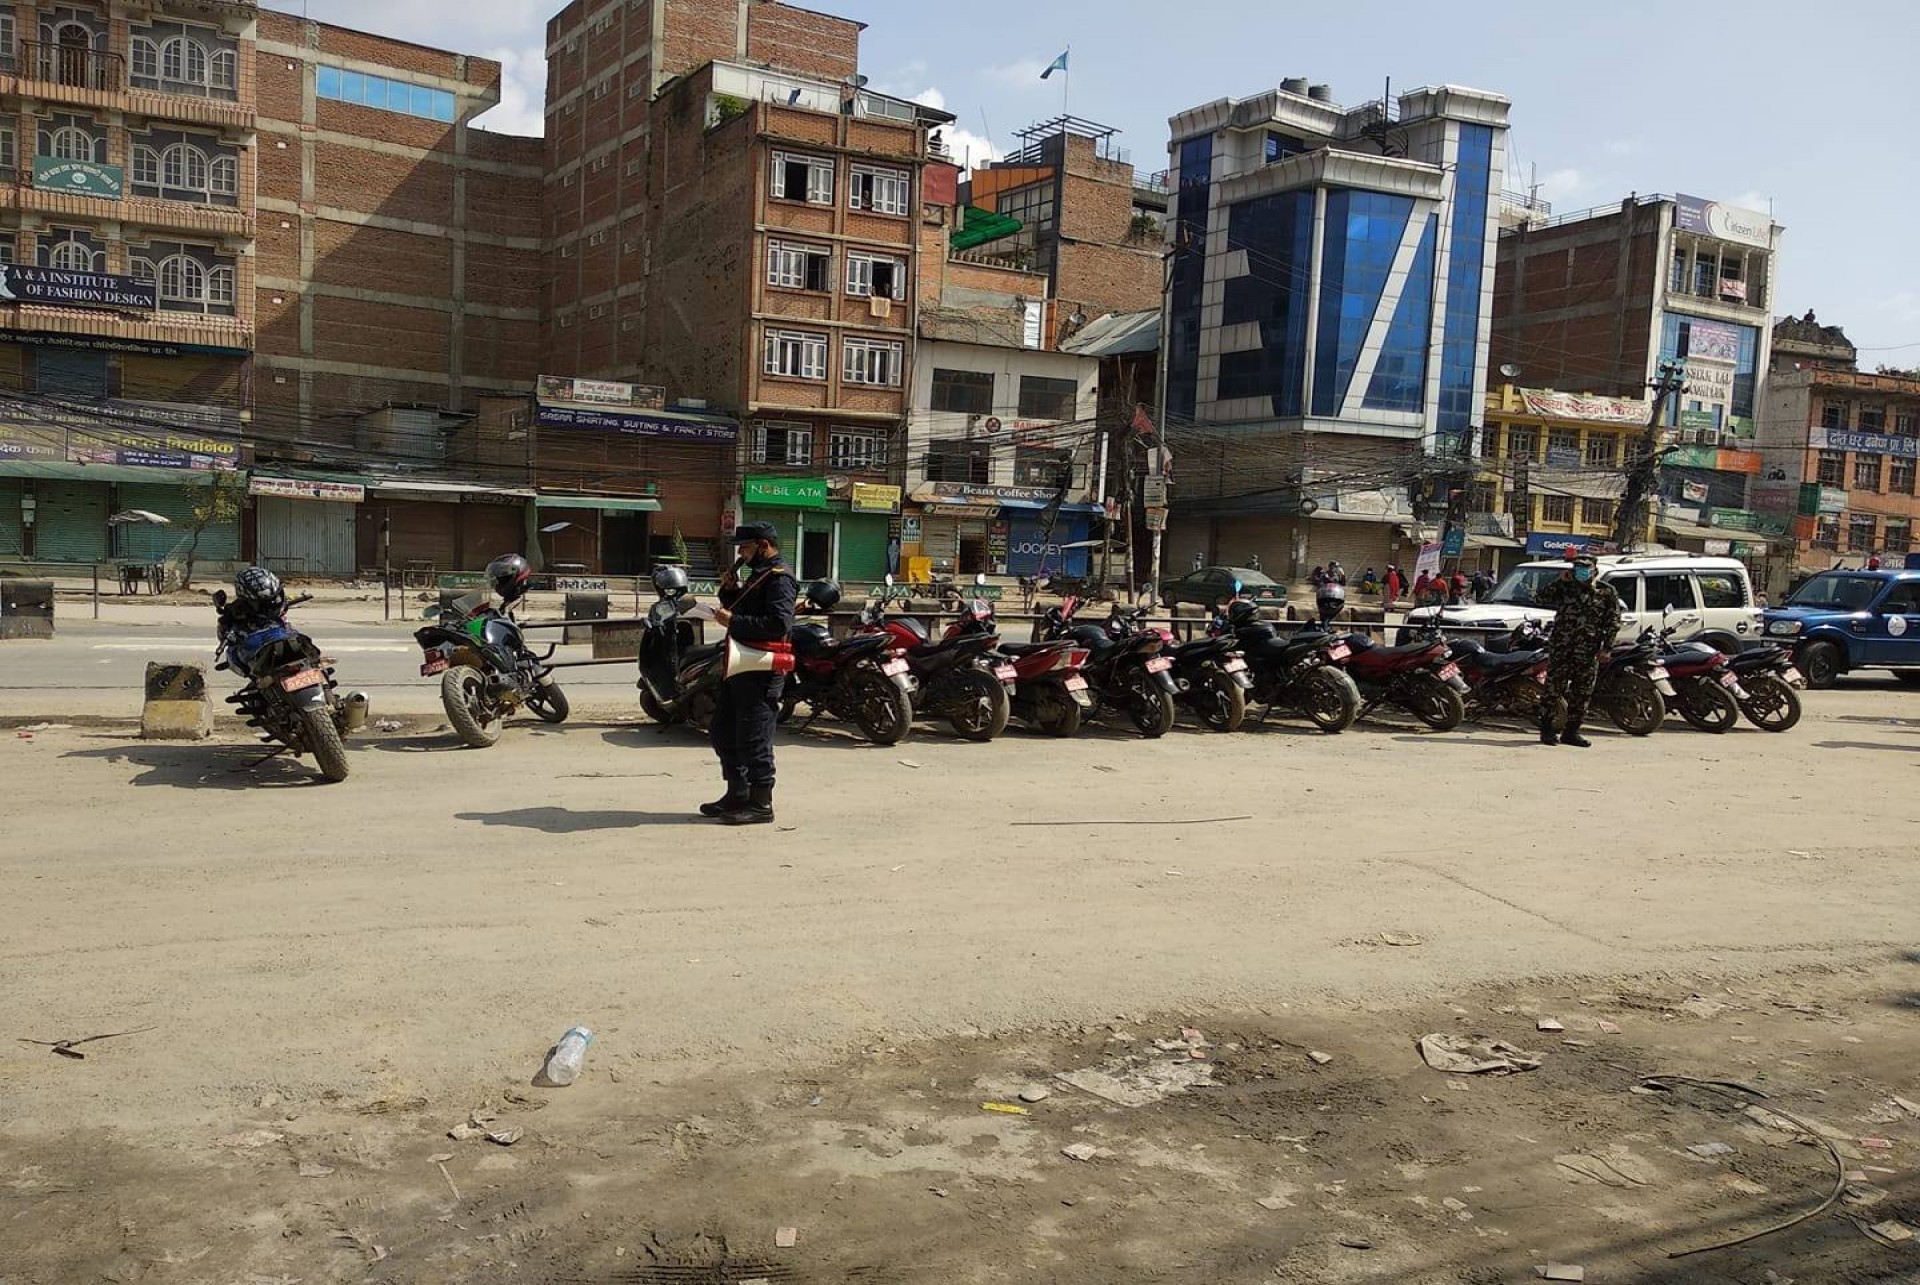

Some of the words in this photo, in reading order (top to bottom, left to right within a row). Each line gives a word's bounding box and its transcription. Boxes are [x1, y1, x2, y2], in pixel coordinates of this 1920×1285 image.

[13, 269, 22, 279] A
[25, 269, 34, 280] &
[39, 271, 47, 282] A
[50, 272, 118, 289] INSTITUTE
[26, 284, 45, 296] OF
[47, 286, 102, 300] FASHION
[105, 292, 153, 306] DESIGN
[540, 411, 573, 422] SAGAR
[624, 420, 660, 431] SUITING
[662, 424, 670, 432] &
[674, 425, 702, 436] FANCY
[706, 429, 736, 439] STORE
[796, 487, 823, 498] ATM
[963, 485, 995, 496] Beans
[996, 488, 1031, 499] Coffee
[1011, 542, 1062, 555] JOCKEY
